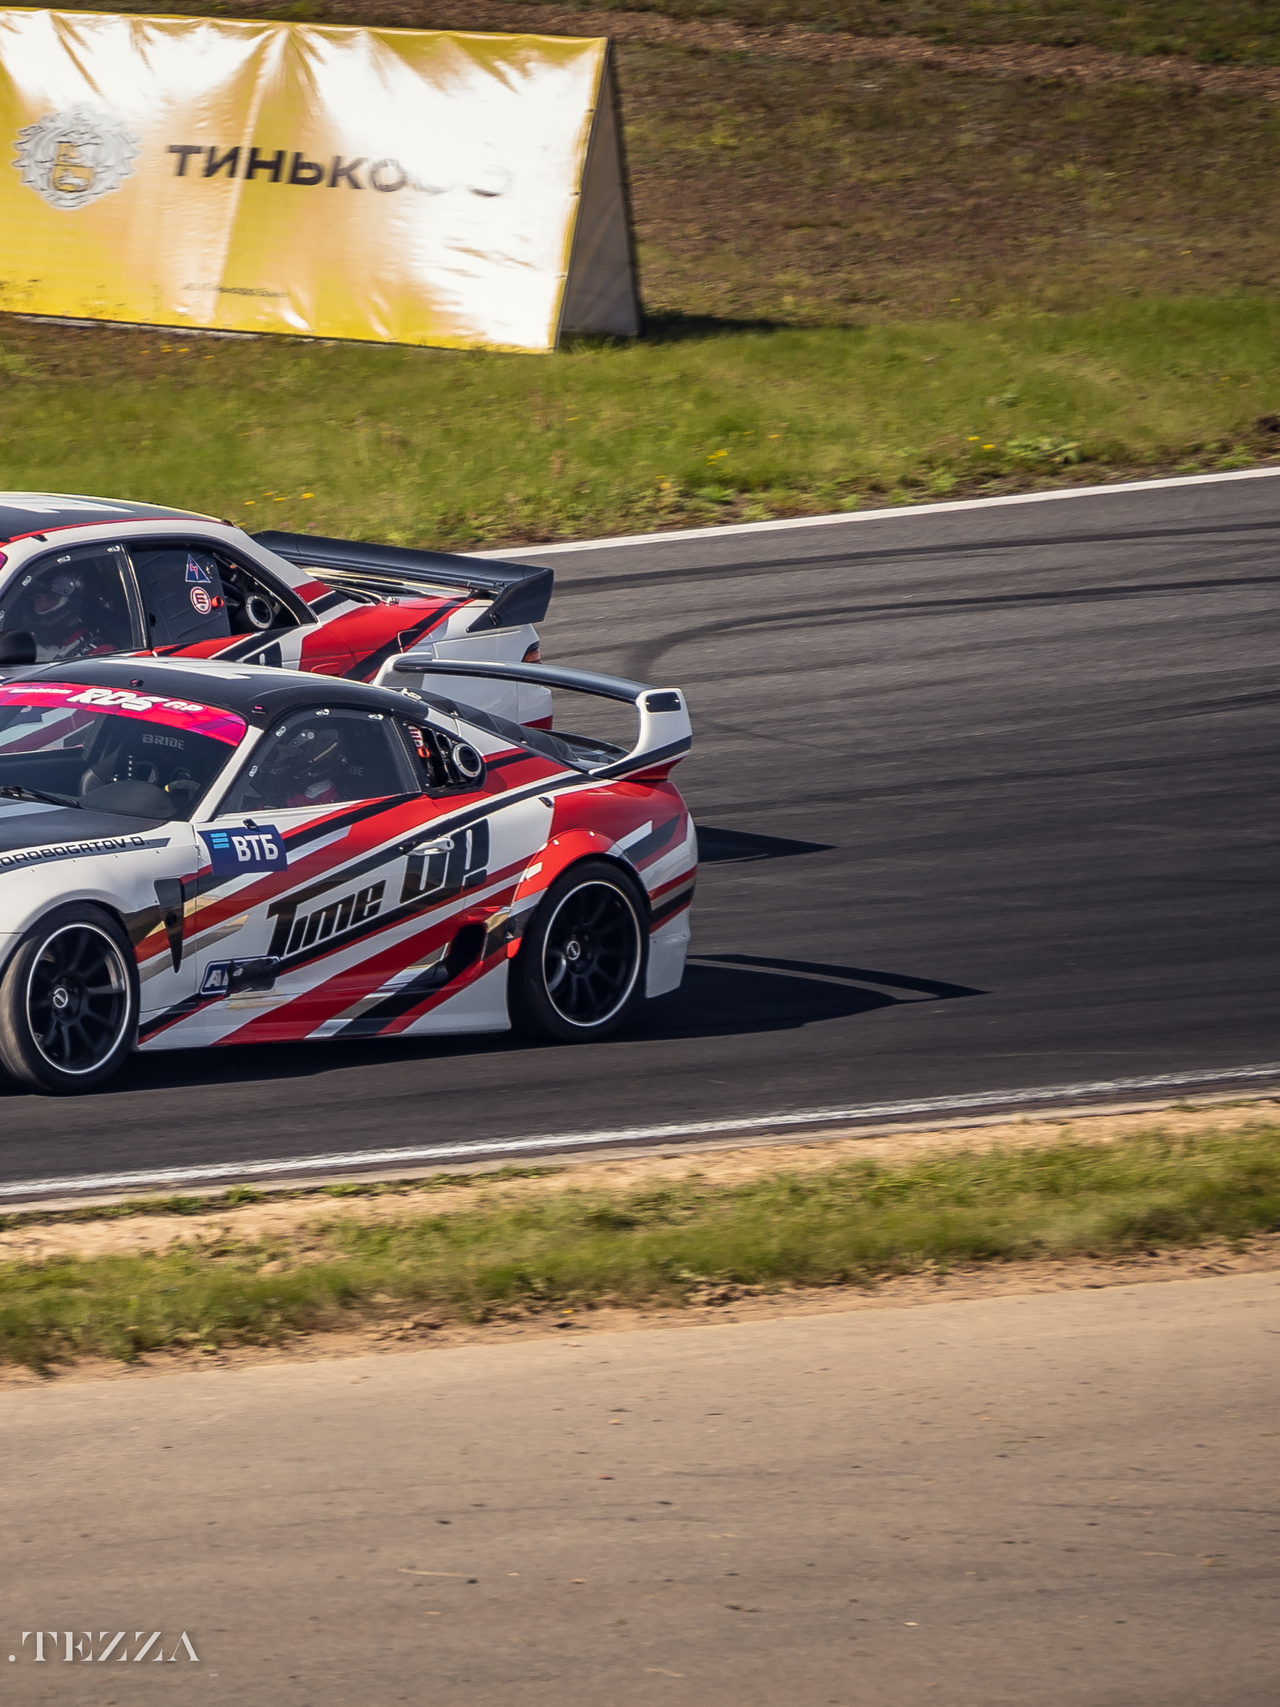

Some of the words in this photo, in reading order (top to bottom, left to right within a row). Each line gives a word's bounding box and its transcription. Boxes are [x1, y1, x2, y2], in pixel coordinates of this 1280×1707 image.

[167, 145, 513, 197] ТИНЬКО
[66, 688, 171, 711] RDS
[142, 733, 185, 750] BRIDE
[231, 834, 279, 862] ВТБ
